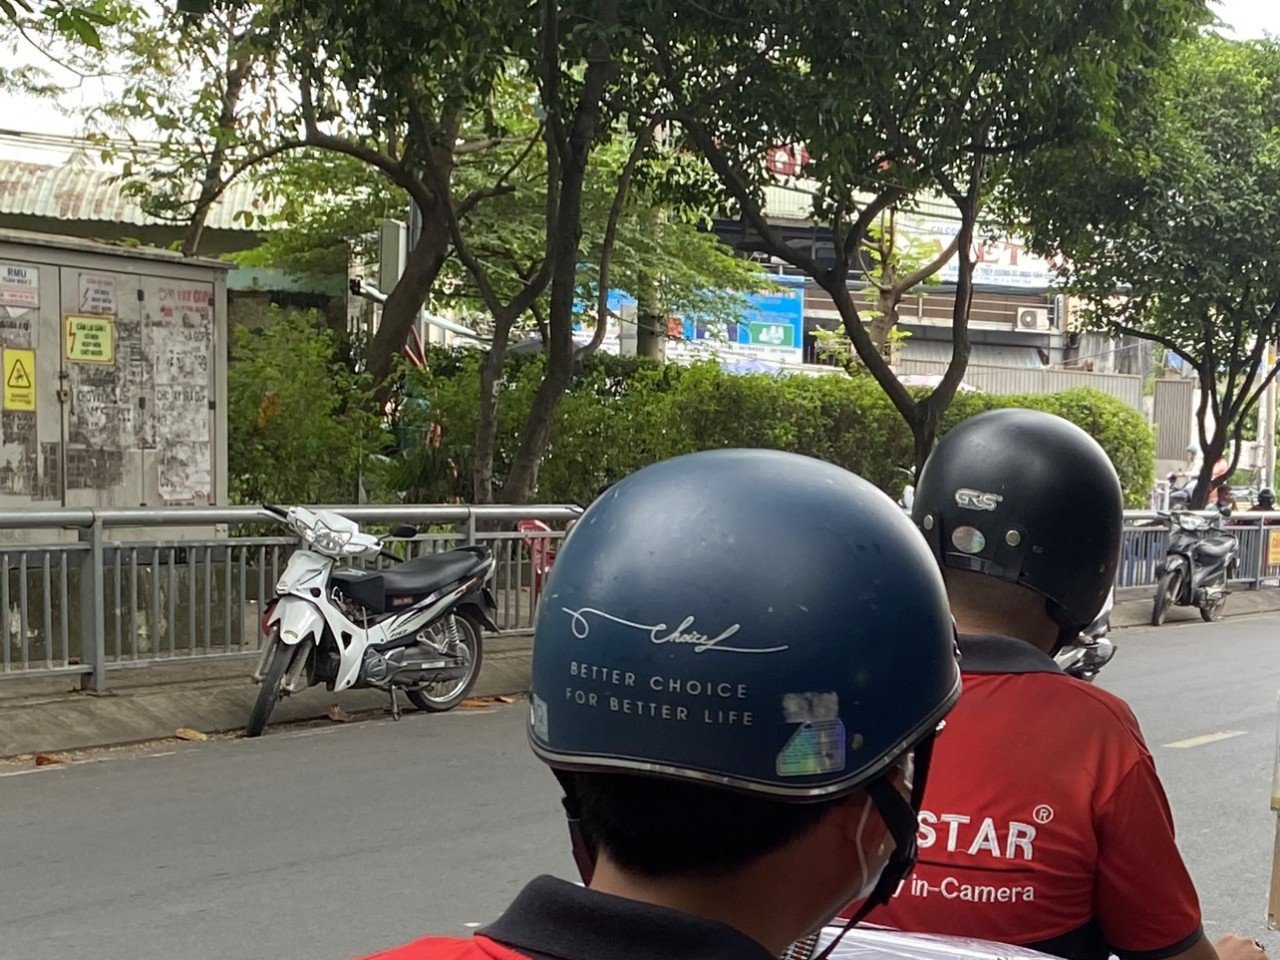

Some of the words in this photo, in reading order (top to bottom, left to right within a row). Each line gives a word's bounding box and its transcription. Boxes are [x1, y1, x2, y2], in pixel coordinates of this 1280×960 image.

[7, 267, 27, 278] RMU
[570, 661, 636, 687] BETTER
[650, 676, 748, 699] CHOICE
[565, 687, 598, 707] FOR
[609, 696, 688, 721] BETTER
[704, 709, 754, 726] LIFE
[911, 873, 1036, 903] in-Camera
